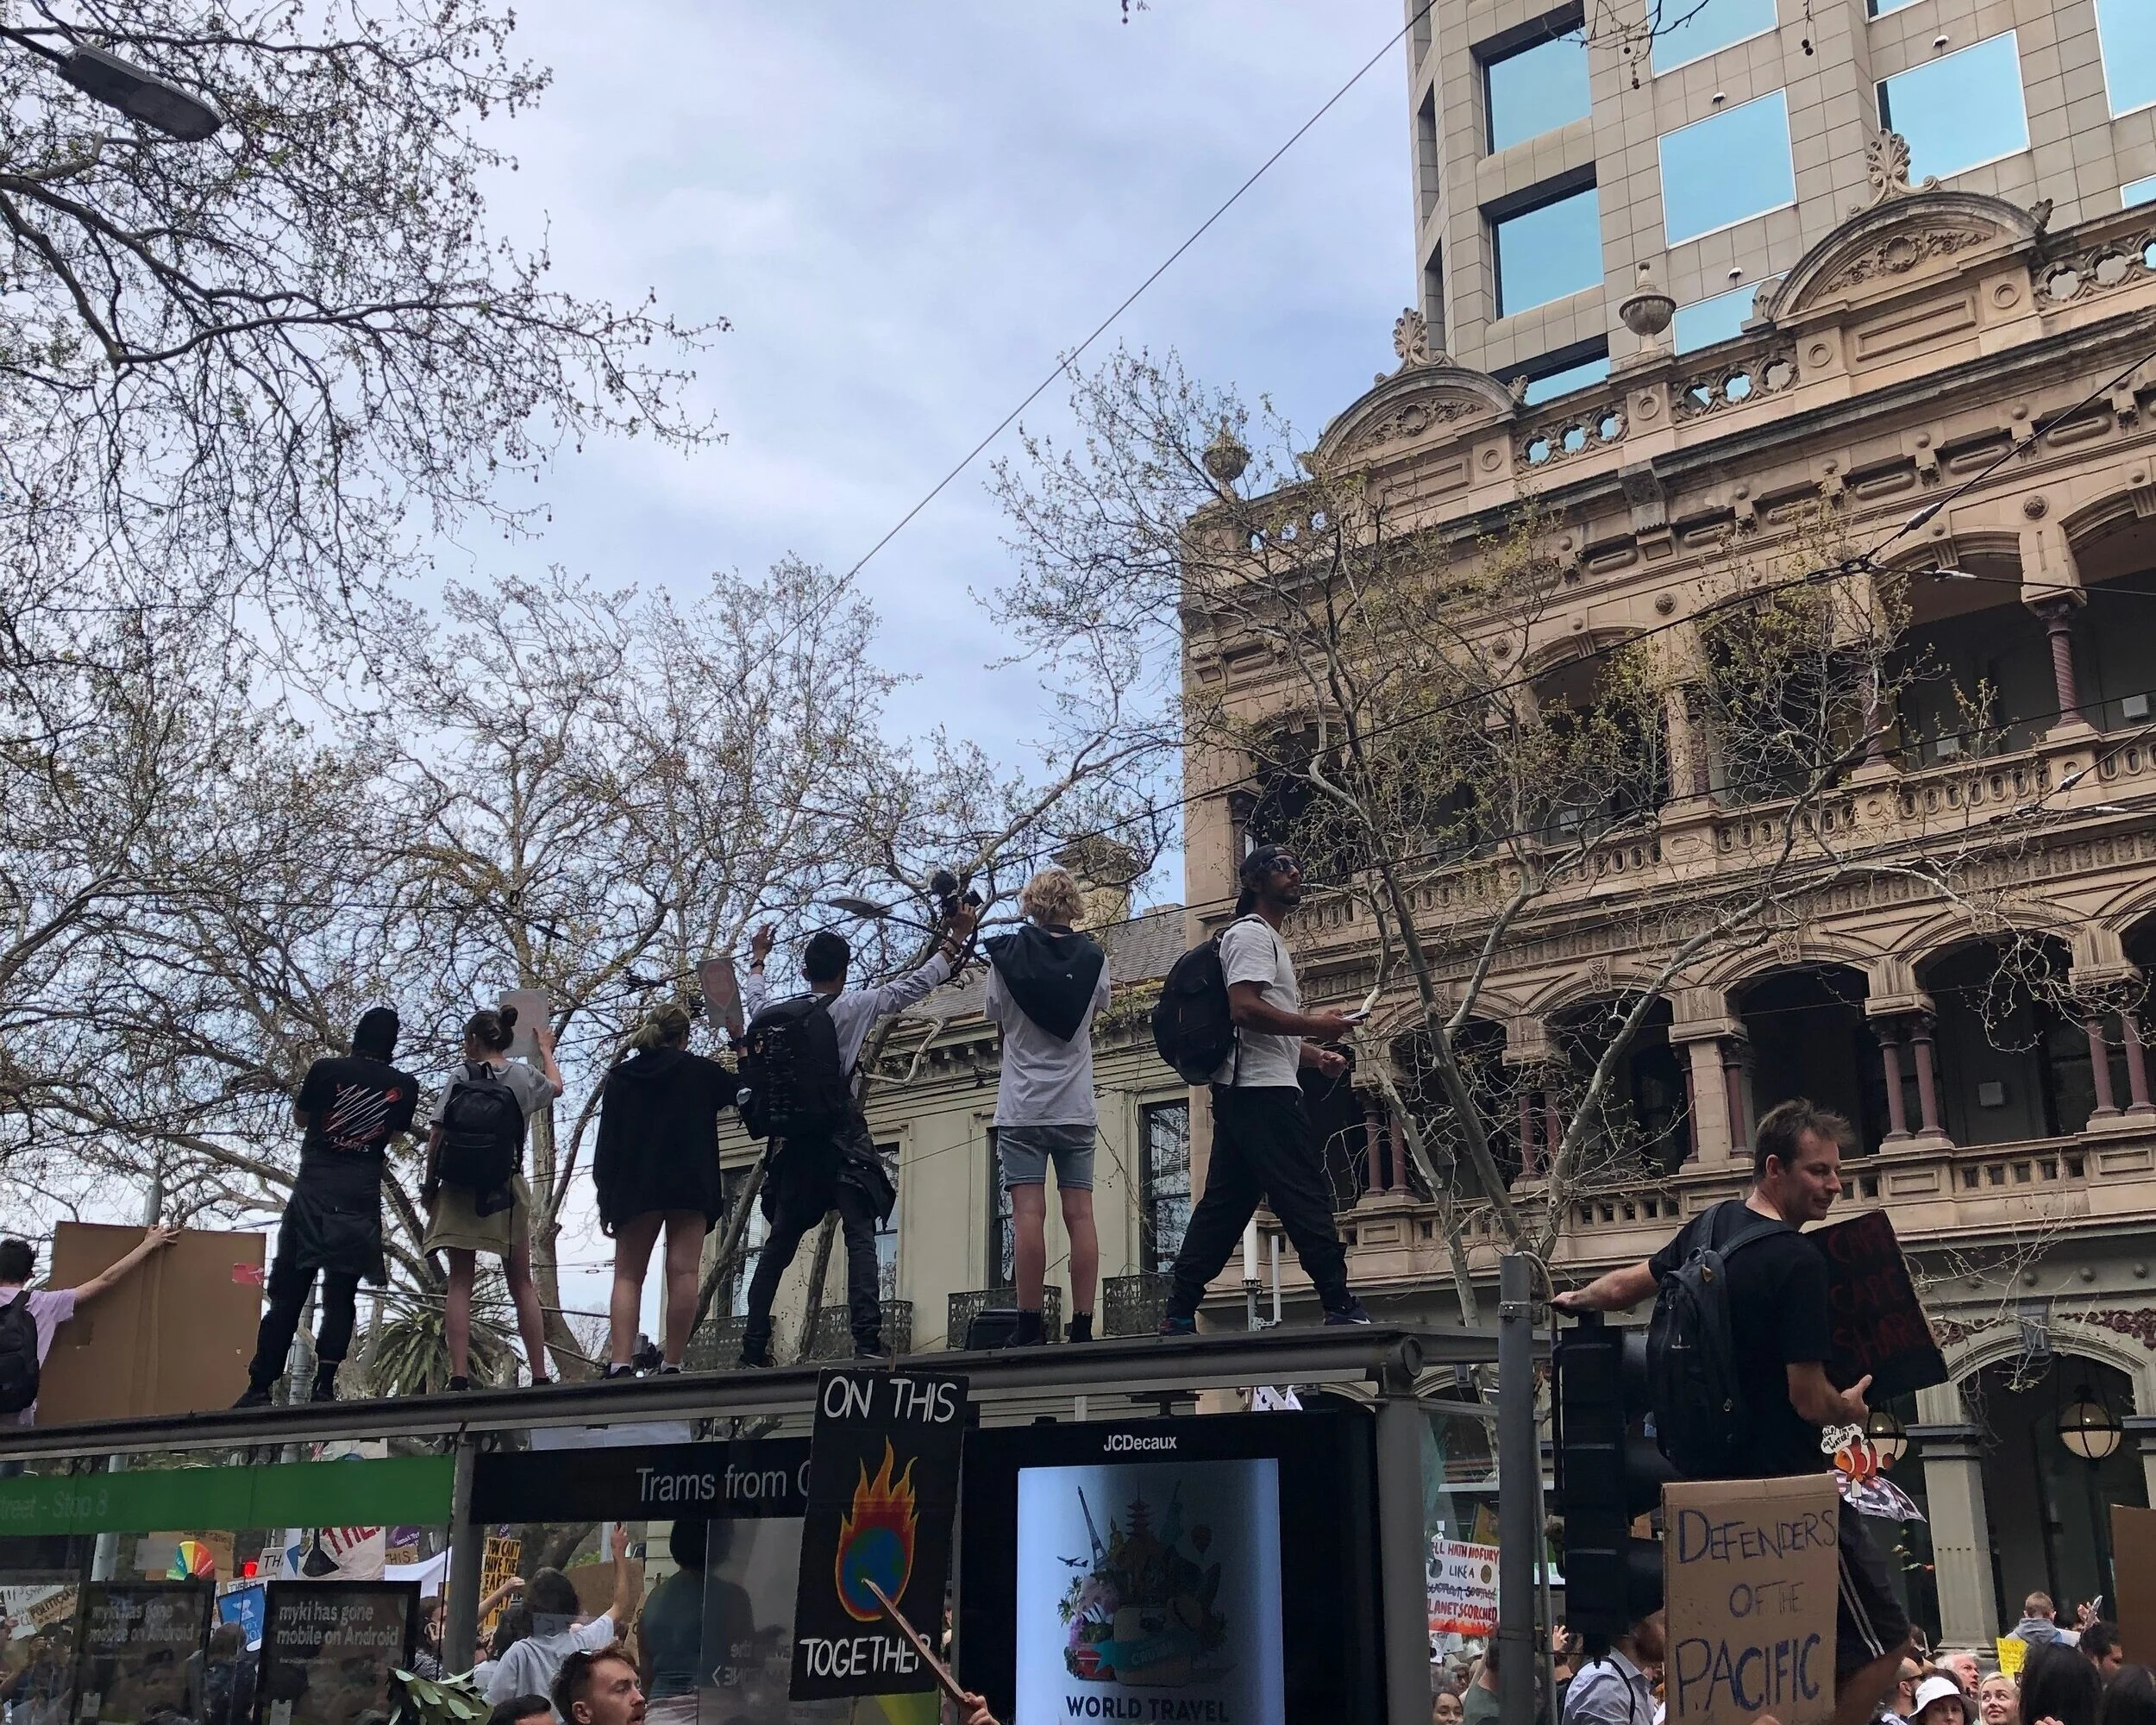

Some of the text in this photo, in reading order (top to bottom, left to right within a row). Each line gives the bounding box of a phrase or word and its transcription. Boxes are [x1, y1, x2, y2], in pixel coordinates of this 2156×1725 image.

[824, 1376, 958, 1423] ON THIS
[1103, 1434, 1177, 1452] JCDecaux
[636, 1467, 715, 1502] Trams
[725, 1464, 787, 1499] from
[1677, 1509, 1837, 1564] DEFENDERS
[485, 1555, 517, 1574] HAVE THE
[1450, 1565, 1475, 1579] LIKE A
[1729, 1581, 1806, 1618] OF THE
[279, 1601, 373, 1626] myki has gone
[276, 1625, 322, 1645] mobile
[324, 1629, 342, 1645] on
[345, 1626, 399, 1647] Android
[1676, 1633, 1821, 1717] PACIFIC
[1065, 1695, 1230, 1722] WORLD TRAVEL
